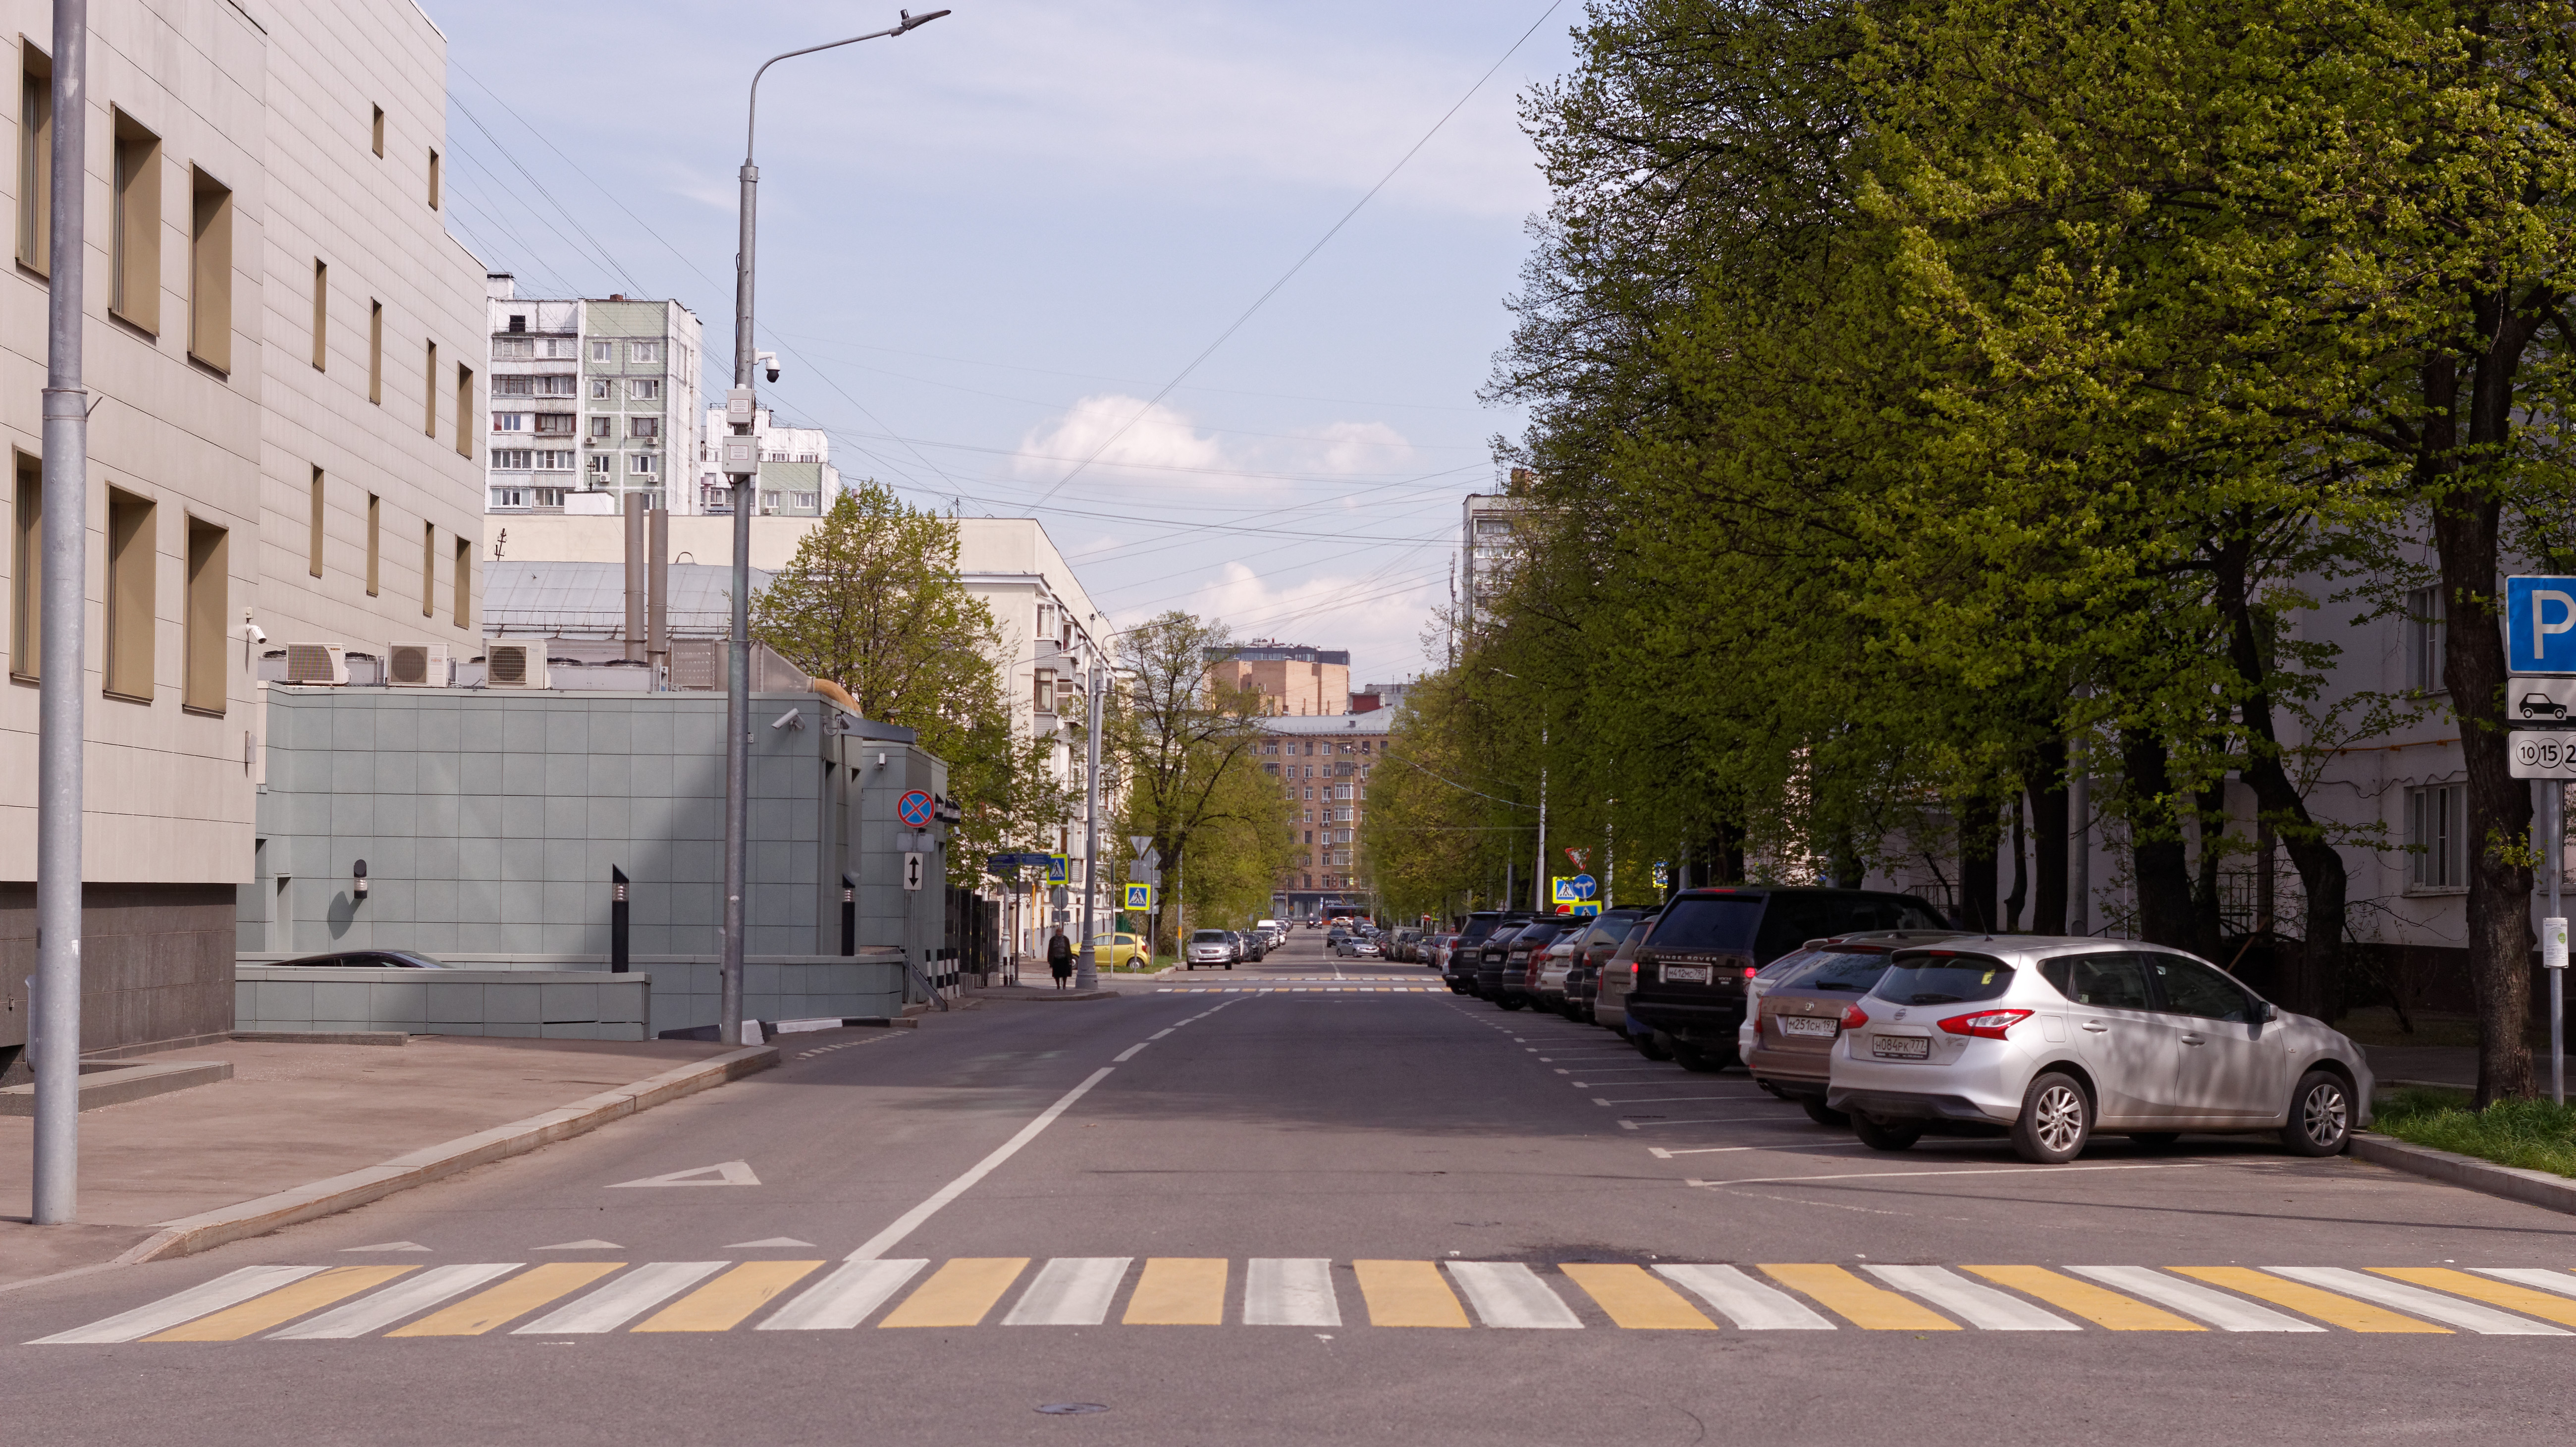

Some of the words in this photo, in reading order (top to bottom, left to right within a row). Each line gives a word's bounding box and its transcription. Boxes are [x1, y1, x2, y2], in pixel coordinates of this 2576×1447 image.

[2532, 590, 2576, 660] P
[2521, 746, 2535, 759] 10
[2541, 745, 2558, 761] 15
